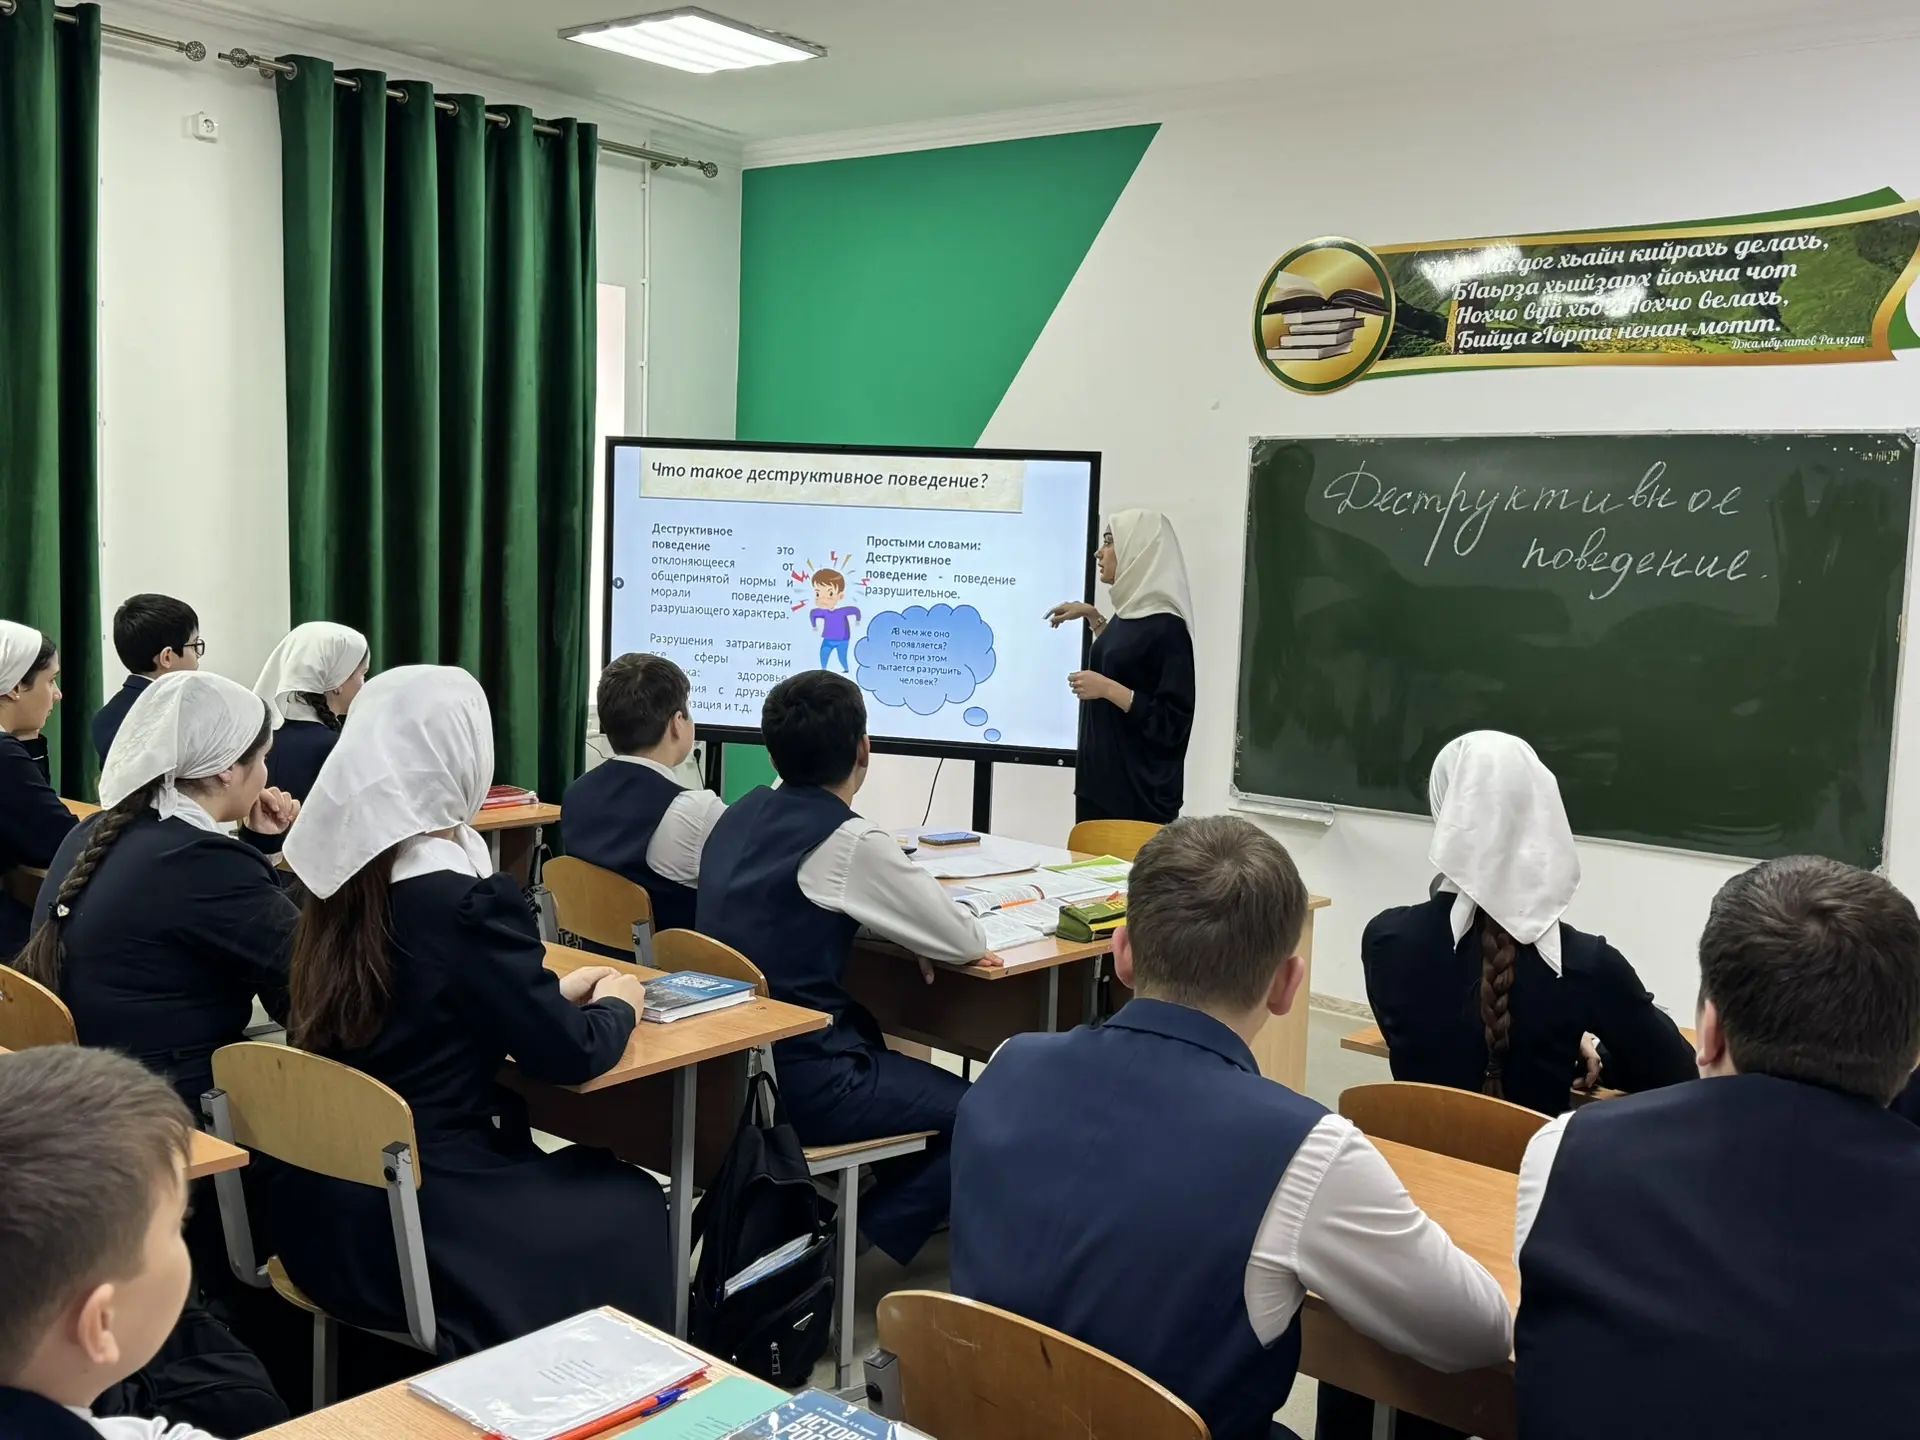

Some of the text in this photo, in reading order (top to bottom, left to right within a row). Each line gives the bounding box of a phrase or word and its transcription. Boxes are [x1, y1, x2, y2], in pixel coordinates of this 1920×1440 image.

[1517, 255, 1554, 277] дог
[1557, 247, 1625, 267] хьайн
[1629, 241, 1728, 265] кийрахь
[1734, 234, 1829, 261] делахь,
[1656, 267, 1740, 287] йоьхна
[1746, 264, 1798, 281] чот
[1455, 306, 1518, 325] Нохчо
[1523, 301, 1562, 325] вуй
[1627, 294, 1692, 314] Нохчо
[1698, 289, 1789, 309] велахь,
[1457, 329, 1526, 351] Бийца
[1617, 323, 1688, 340] ненан
[1692, 317, 1781, 336] мотт.
[1819, 334, 1865, 347] Рамзан
[651, 462, 989, 491] Что такое деструктивное поведение?
[1323, 460, 1741, 567] Деструктивное
[652, 523, 733, 537] Деструктивное
[652, 541, 711, 552] поведение
[776, 546, 795, 556] это
[866, 536, 981, 551] Простыми словами:
[651, 556, 794, 571] отклоняющееся от
[866, 552, 951, 566] Деструктивное
[651, 571, 794, 588] общепринятой нормы и
[865, 569, 927, 582] поведение
[953, 573, 1016, 586] поведение
[650, 588, 793, 605] морали поведение,
[865, 585, 961, 600] разрушительное.
[650, 603, 789, 620] разрушающего характера.
[902, 629, 918, 637] чем
[650, 633, 792, 651] Разрушения затрагивают
[890, 640, 948, 650] проявляется?
[694, 653, 729, 664] сферы
[756, 657, 791, 667] жизни
[892, 652, 907, 660] Что
[909, 654, 925, 663] при
[877, 664, 962, 676] пытается разрушить
[899, 677, 938, 686] человек?
[734, 702, 752, 713] т.д.
